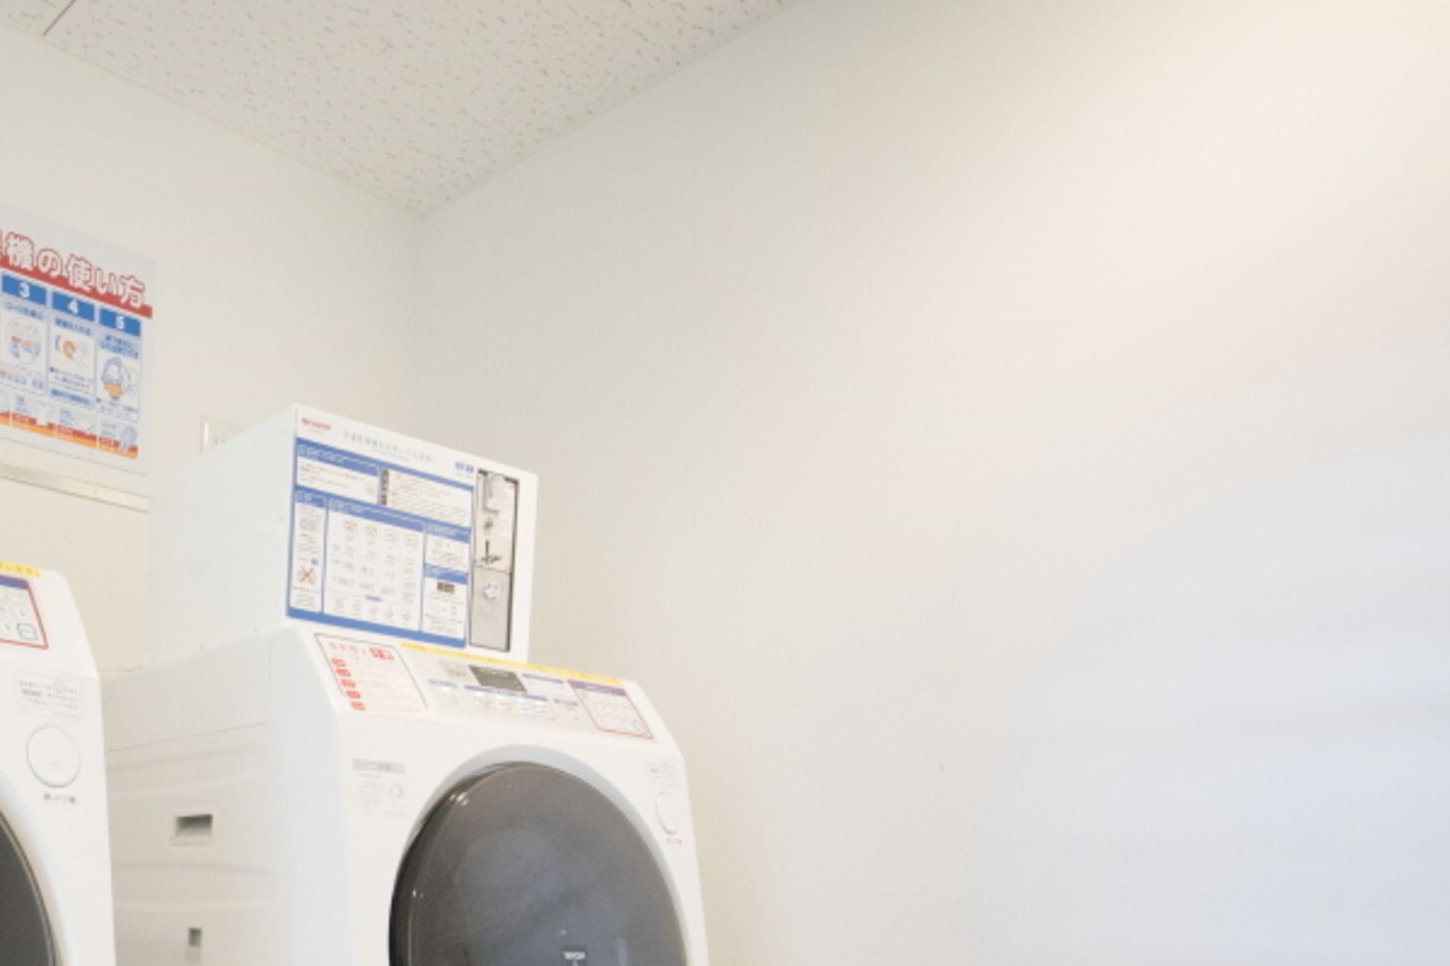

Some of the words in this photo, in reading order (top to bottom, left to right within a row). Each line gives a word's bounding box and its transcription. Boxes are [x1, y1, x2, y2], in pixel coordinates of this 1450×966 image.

[18, 282, 31, 297] 3
[66, 300, 79, 314] 4
[116, 316, 125, 330] 5
